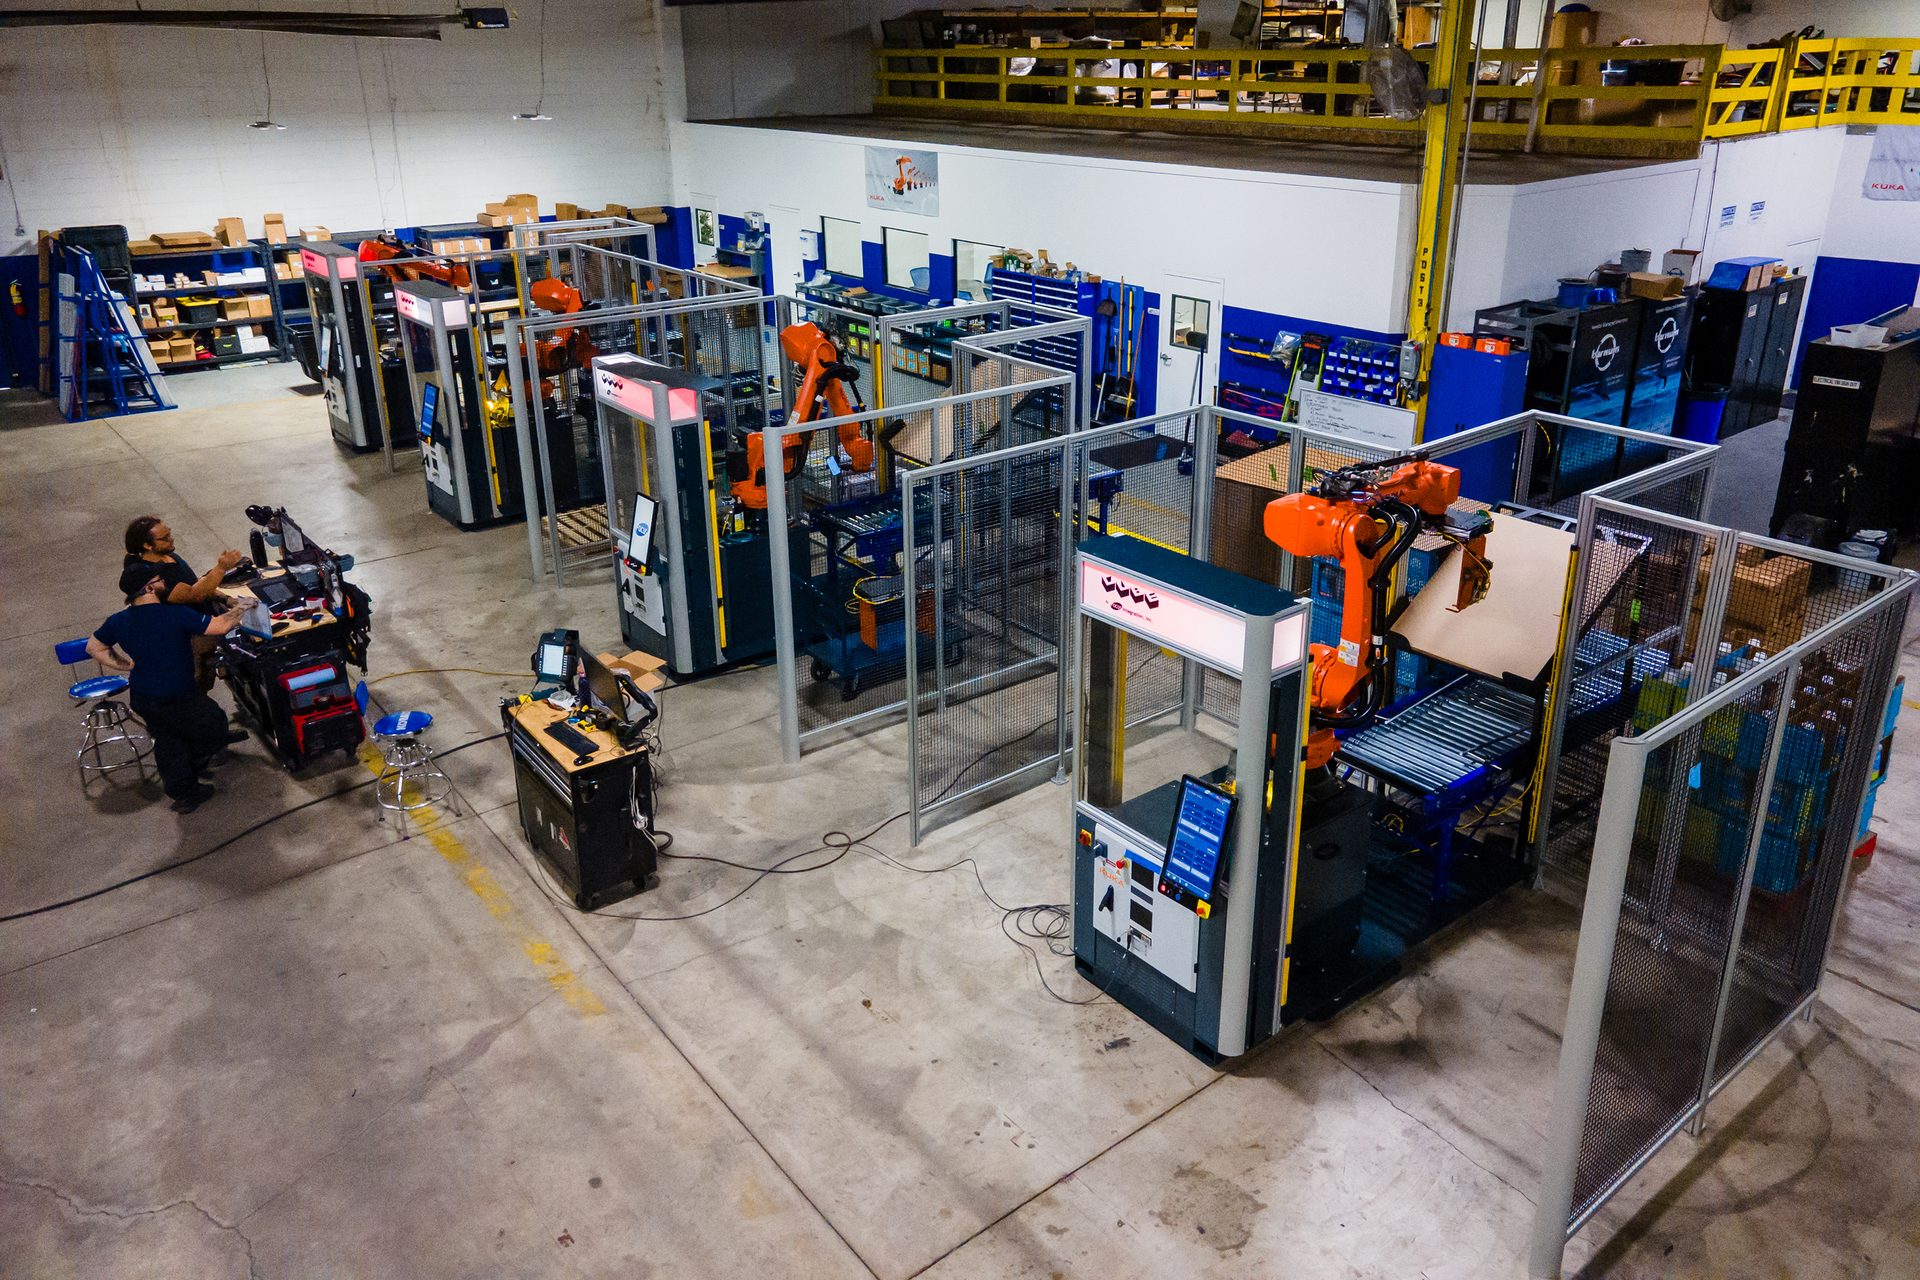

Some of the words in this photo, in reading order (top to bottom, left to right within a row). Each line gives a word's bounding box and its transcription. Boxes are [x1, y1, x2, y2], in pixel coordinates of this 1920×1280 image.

[1871, 183, 1904, 191] KUKA
[1419, 248, 1429, 295] POST
[1417, 299, 1423, 307] 3
